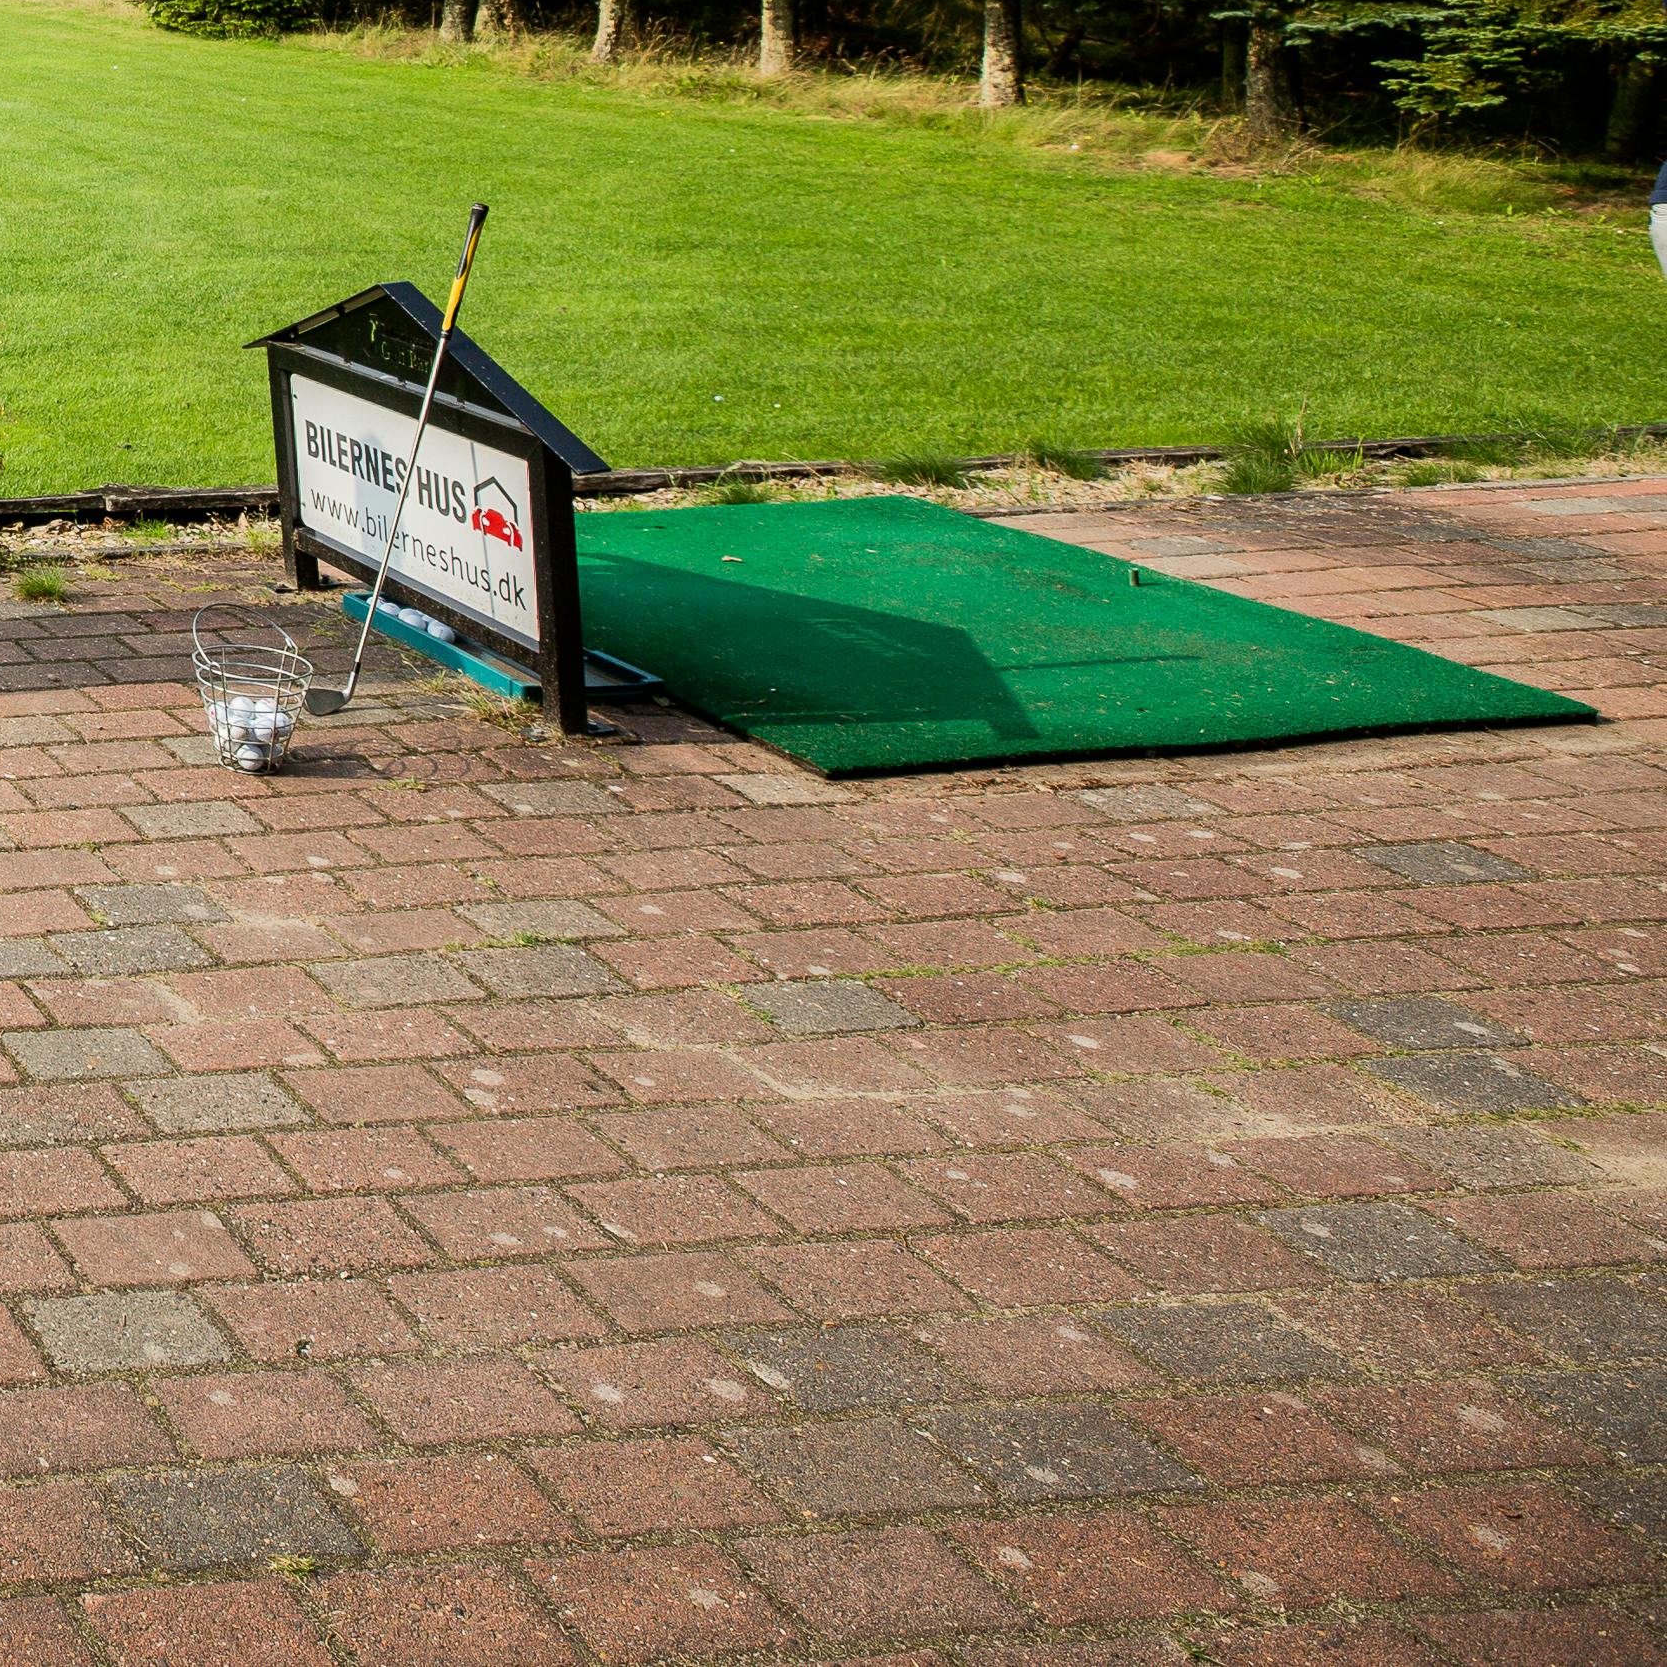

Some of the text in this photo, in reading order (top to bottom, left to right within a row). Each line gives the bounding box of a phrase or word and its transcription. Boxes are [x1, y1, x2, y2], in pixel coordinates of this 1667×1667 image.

[305, 420, 467, 523] BILERNES HUS
[311, 489, 527, 610] www.bilerneshus.dk
